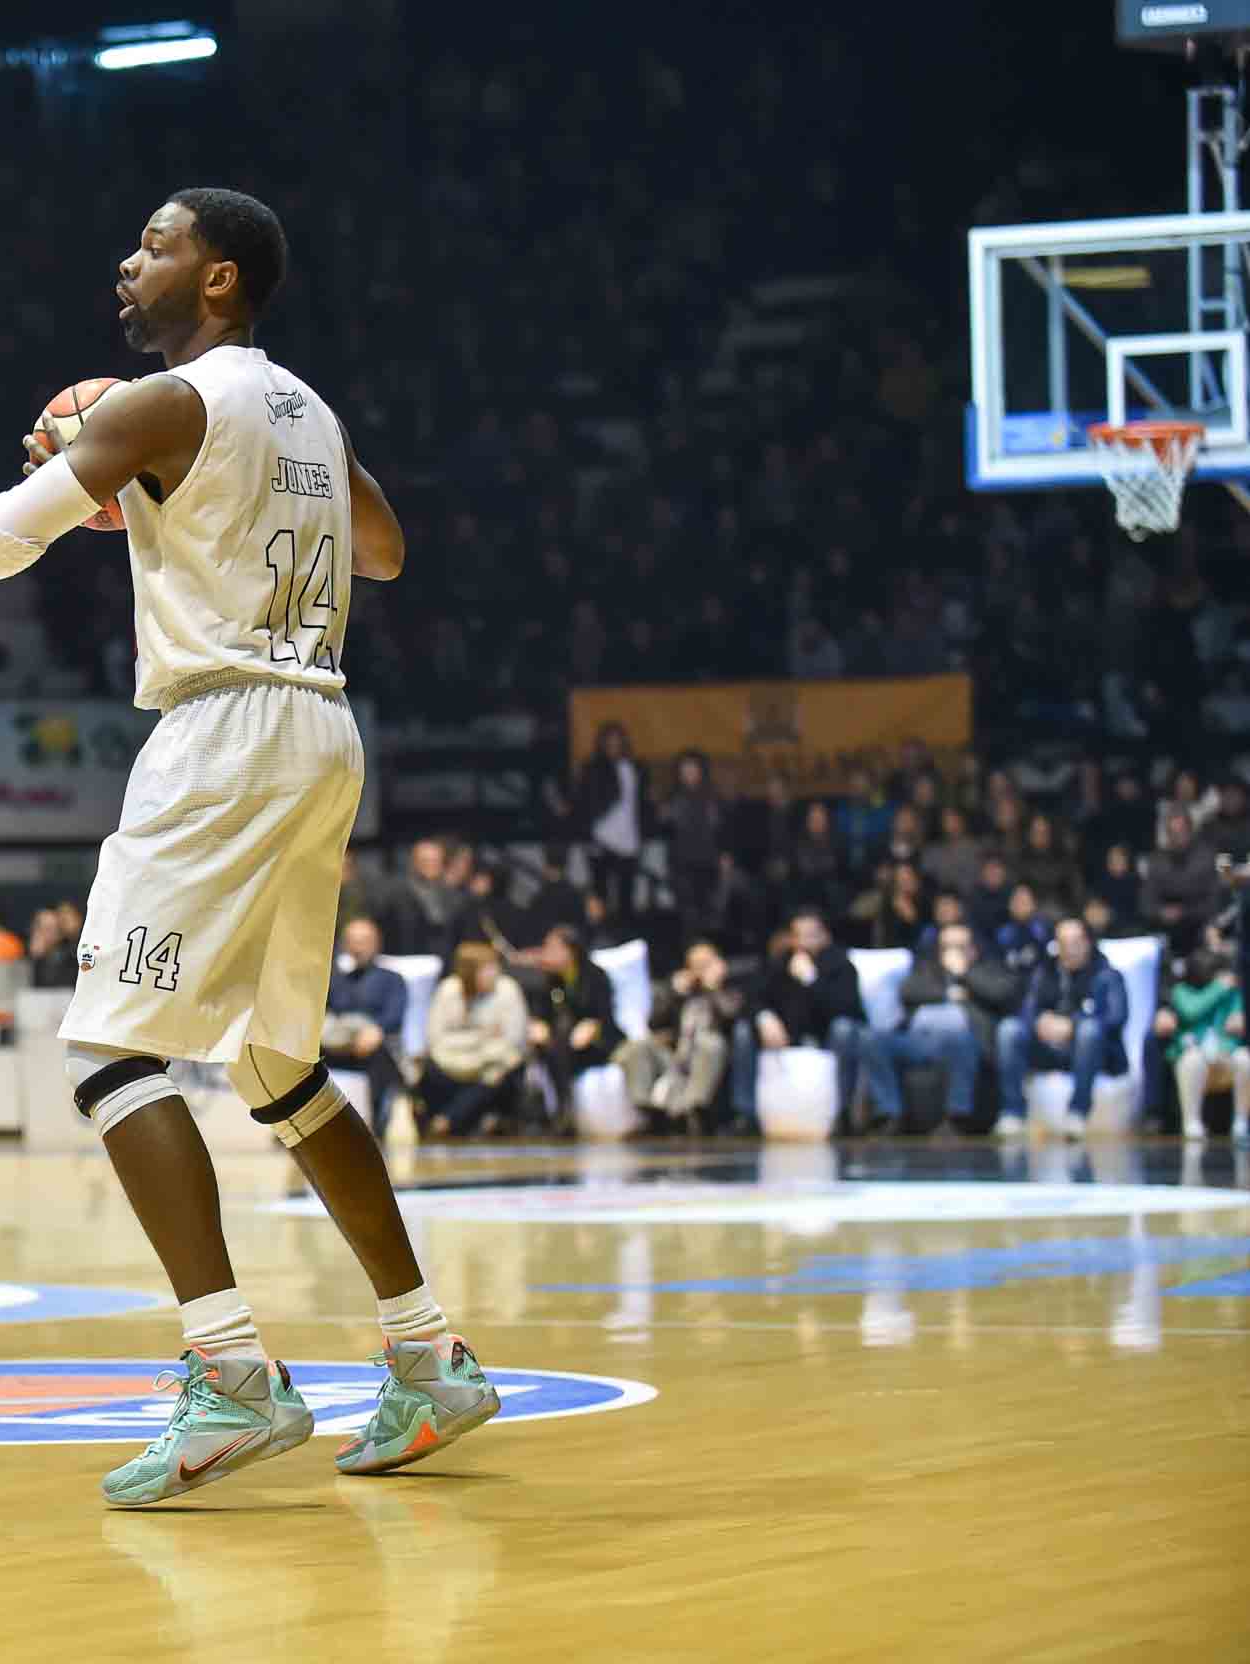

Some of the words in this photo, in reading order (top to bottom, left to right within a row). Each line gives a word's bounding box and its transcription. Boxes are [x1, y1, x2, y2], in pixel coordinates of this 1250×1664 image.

[272, 457, 333, 499] JONES
[265, 529, 338, 672] 14
[119, 926, 182, 991] 14
